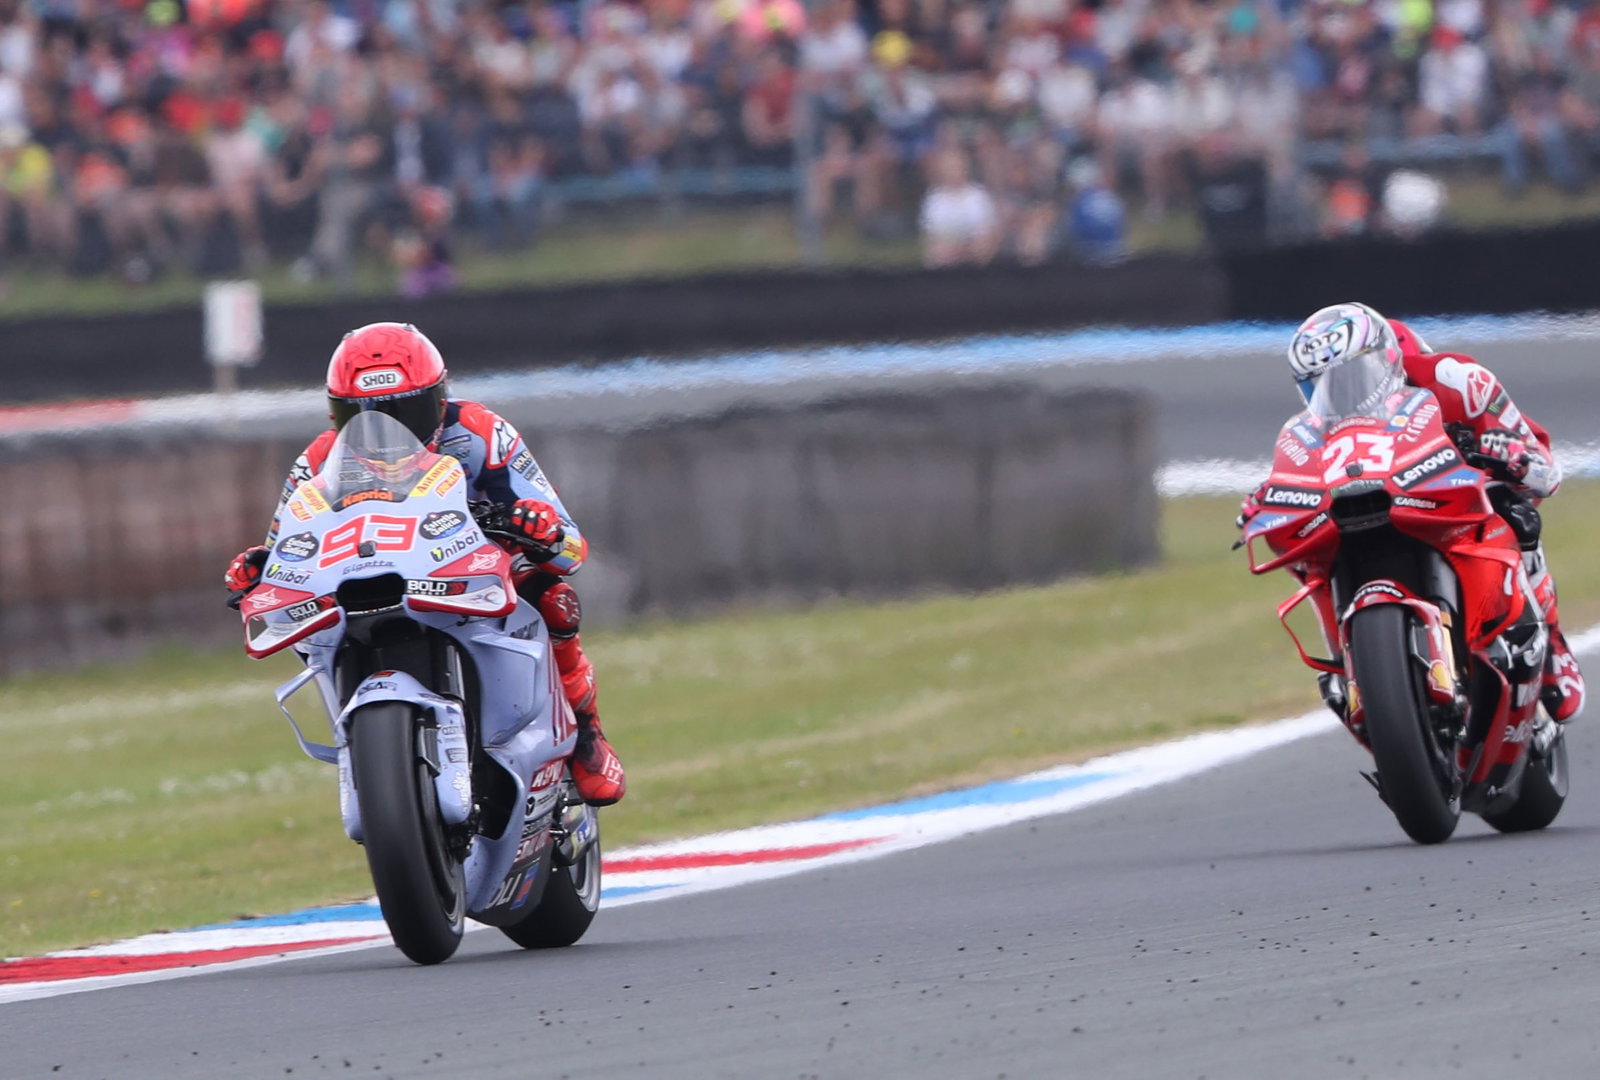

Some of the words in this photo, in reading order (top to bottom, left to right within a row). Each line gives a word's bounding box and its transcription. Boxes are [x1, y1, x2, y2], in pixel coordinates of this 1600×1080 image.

[363, 373, 396, 387] SHOEI
[1321, 433, 1394, 484] 23
[1392, 448, 1456, 488] Lenovo
[1264, 487, 1322, 507] Lenovo
[423, 513, 457, 532] Estrella
[430, 518, 461, 536] Galicia
[318, 513, 420, 570] 93
[430, 531, 480, 563] Unibat
[265, 563, 312, 586] Unibat
[407, 580, 448, 592] BOLD
[288, 601, 317, 618] BOLD
